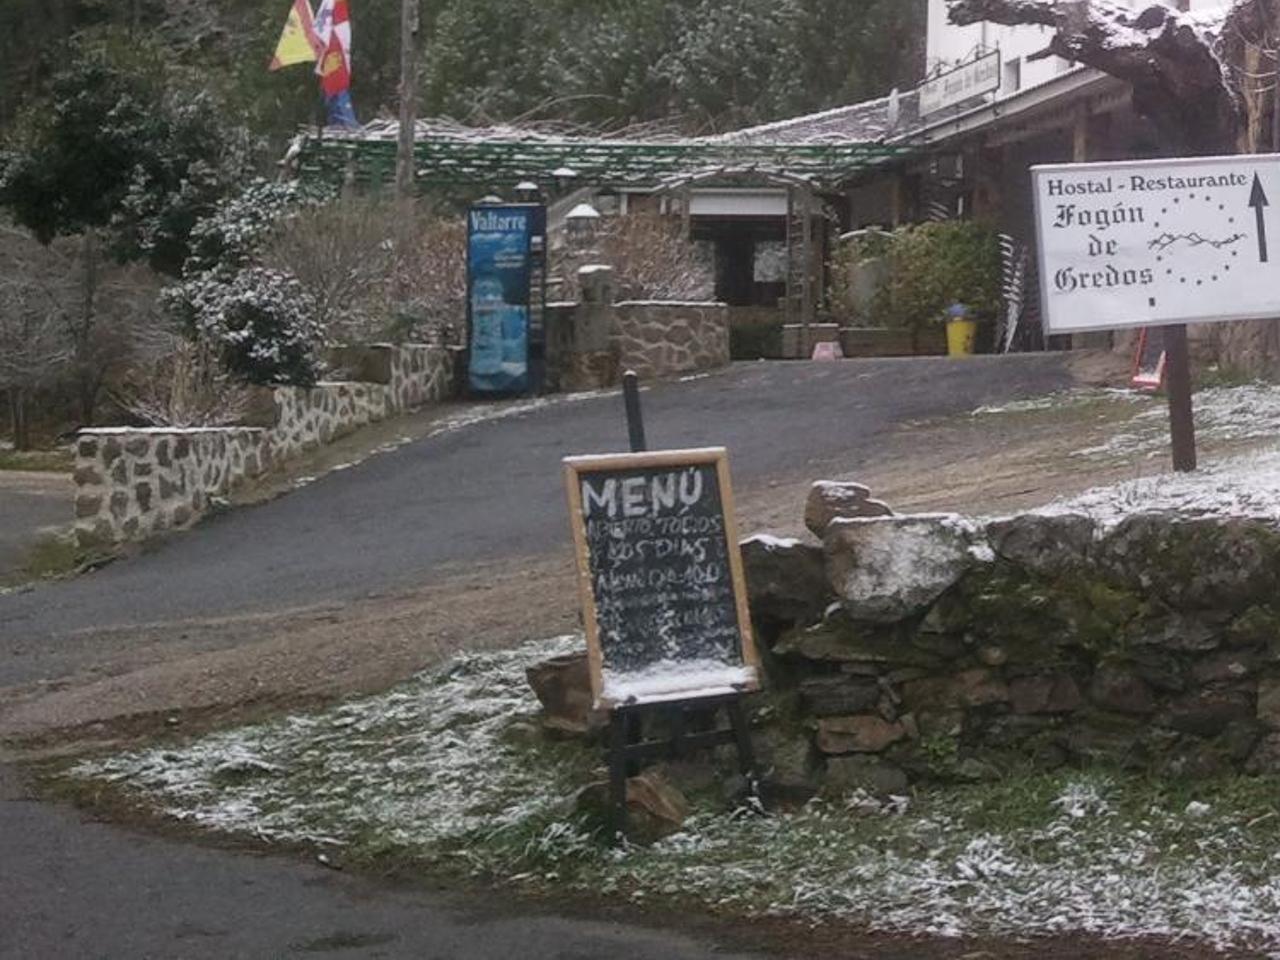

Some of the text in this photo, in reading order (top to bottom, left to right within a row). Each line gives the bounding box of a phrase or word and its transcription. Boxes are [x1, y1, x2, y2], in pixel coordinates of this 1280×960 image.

[1048, 178, 1113, 196] Hostal
[1130, 173, 1248, 191] Restaurante
[1053, 202, 1145, 230] Fogón
[1088, 234, 1119, 257] de
[1055, 265, 1153, 291] Gredos
[582, 467, 703, 519] MENÚ
